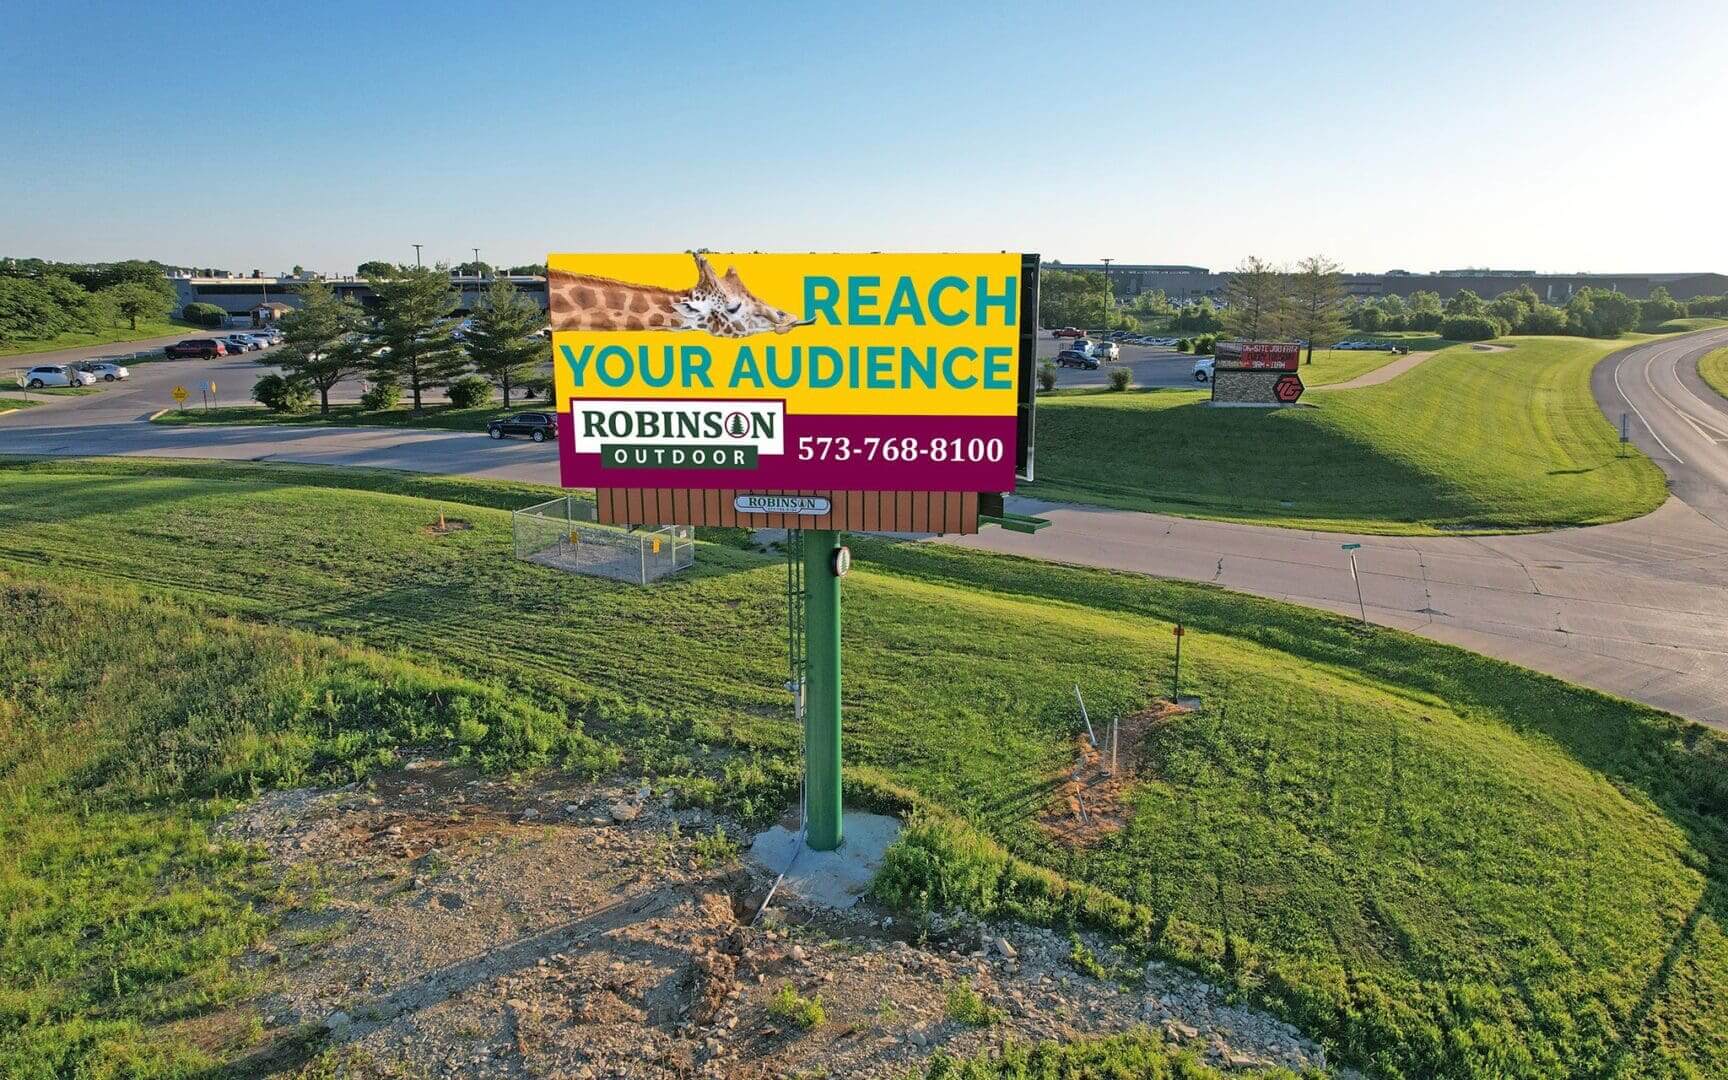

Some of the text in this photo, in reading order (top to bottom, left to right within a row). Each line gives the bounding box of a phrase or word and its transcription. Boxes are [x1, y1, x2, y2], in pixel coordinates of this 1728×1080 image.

[803, 275, 1017, 326] REACH
[560, 345, 1013, 389] YOUR AUDIENCE
[581, 410, 776, 439] ROBINSON
[614, 449, 746, 465] OUTDOOR
[798, 437, 1004, 463] 573-768-8100
[748, 497, 816, 508] ROBINSON
